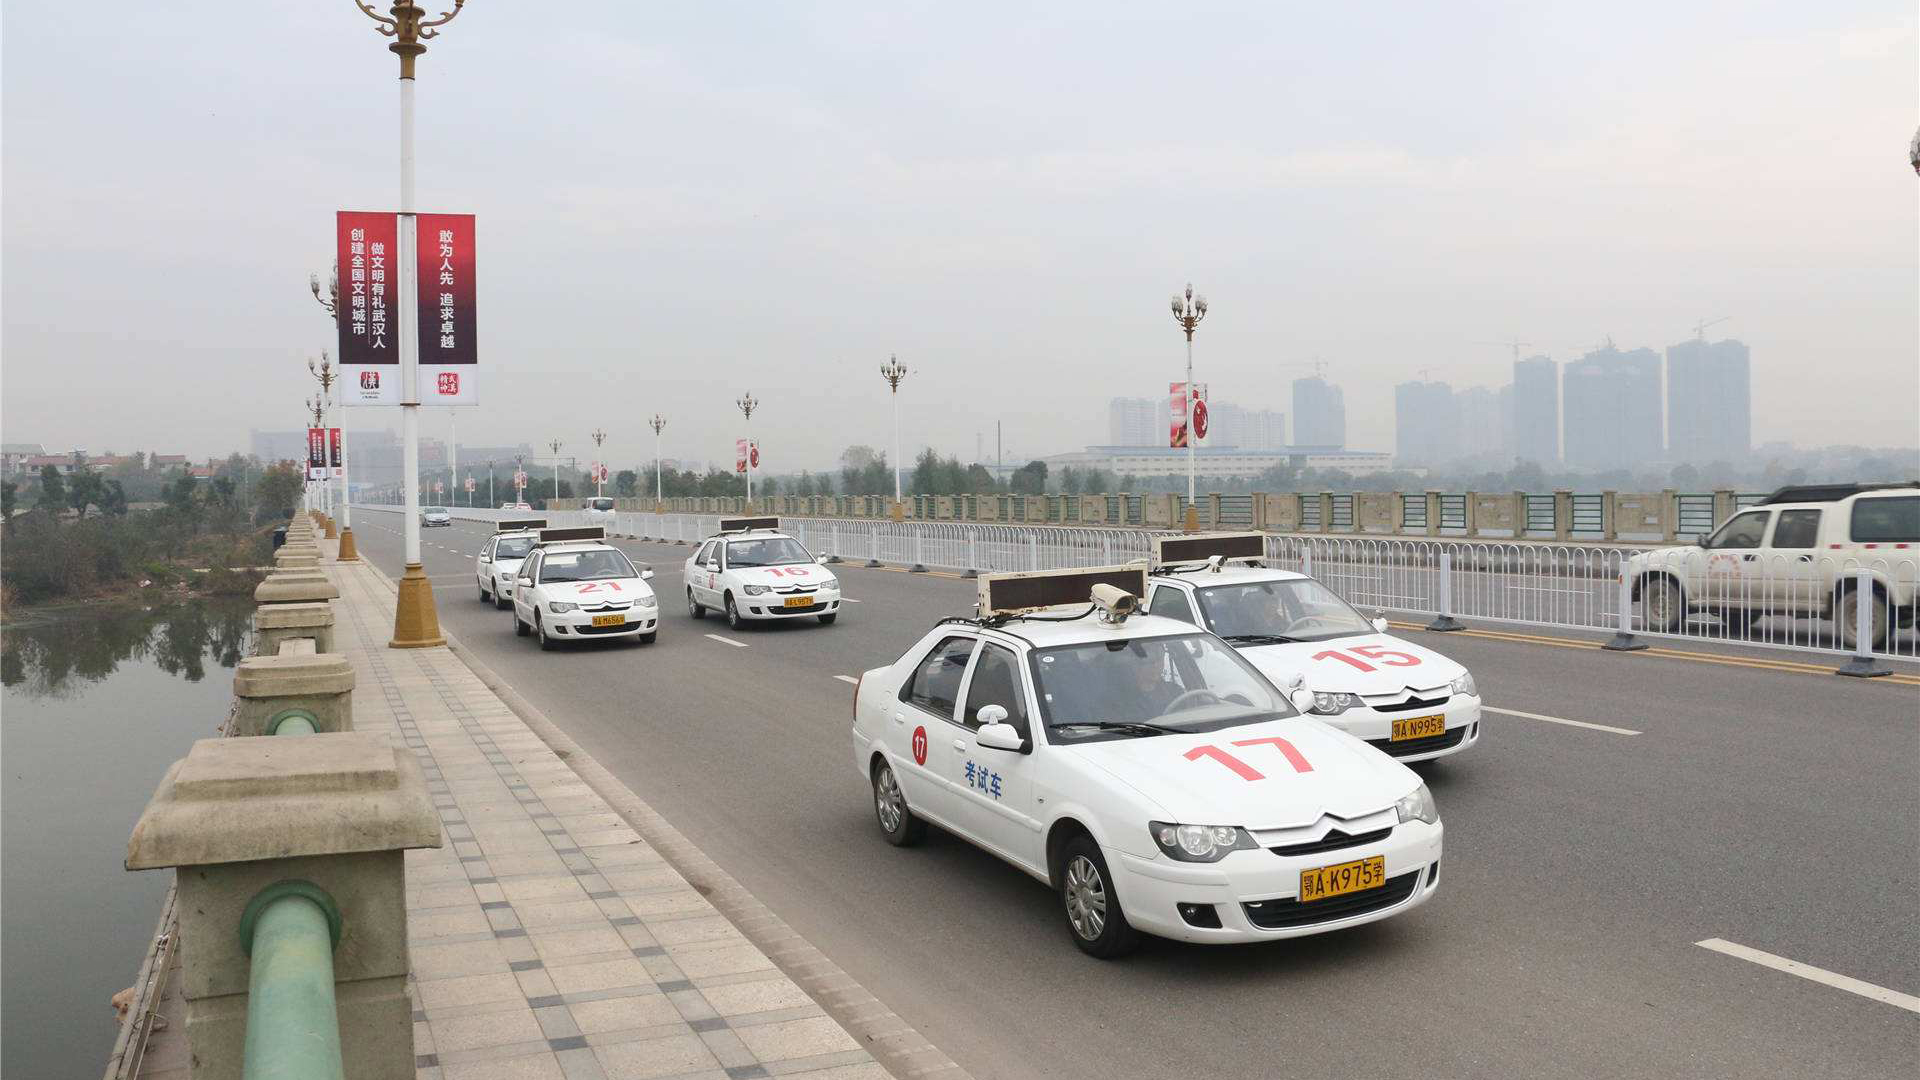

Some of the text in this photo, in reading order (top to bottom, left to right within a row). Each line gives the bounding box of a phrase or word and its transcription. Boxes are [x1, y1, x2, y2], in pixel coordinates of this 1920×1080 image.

[350, 228, 366, 336] 创建全国文明城市
[371, 242, 386, 349] 做文明有礼武汉人
[439, 230, 455, 349] 敢为人先 追求卓越
[575, 582, 621, 593] 21
[764, 567, 809, 577] 16
[1311, 645, 1422, 673] 15
[914, 735, 925, 758] 17
[1183, 736, 1314, 781] 17
[965, 760, 1002, 800] 考试车
